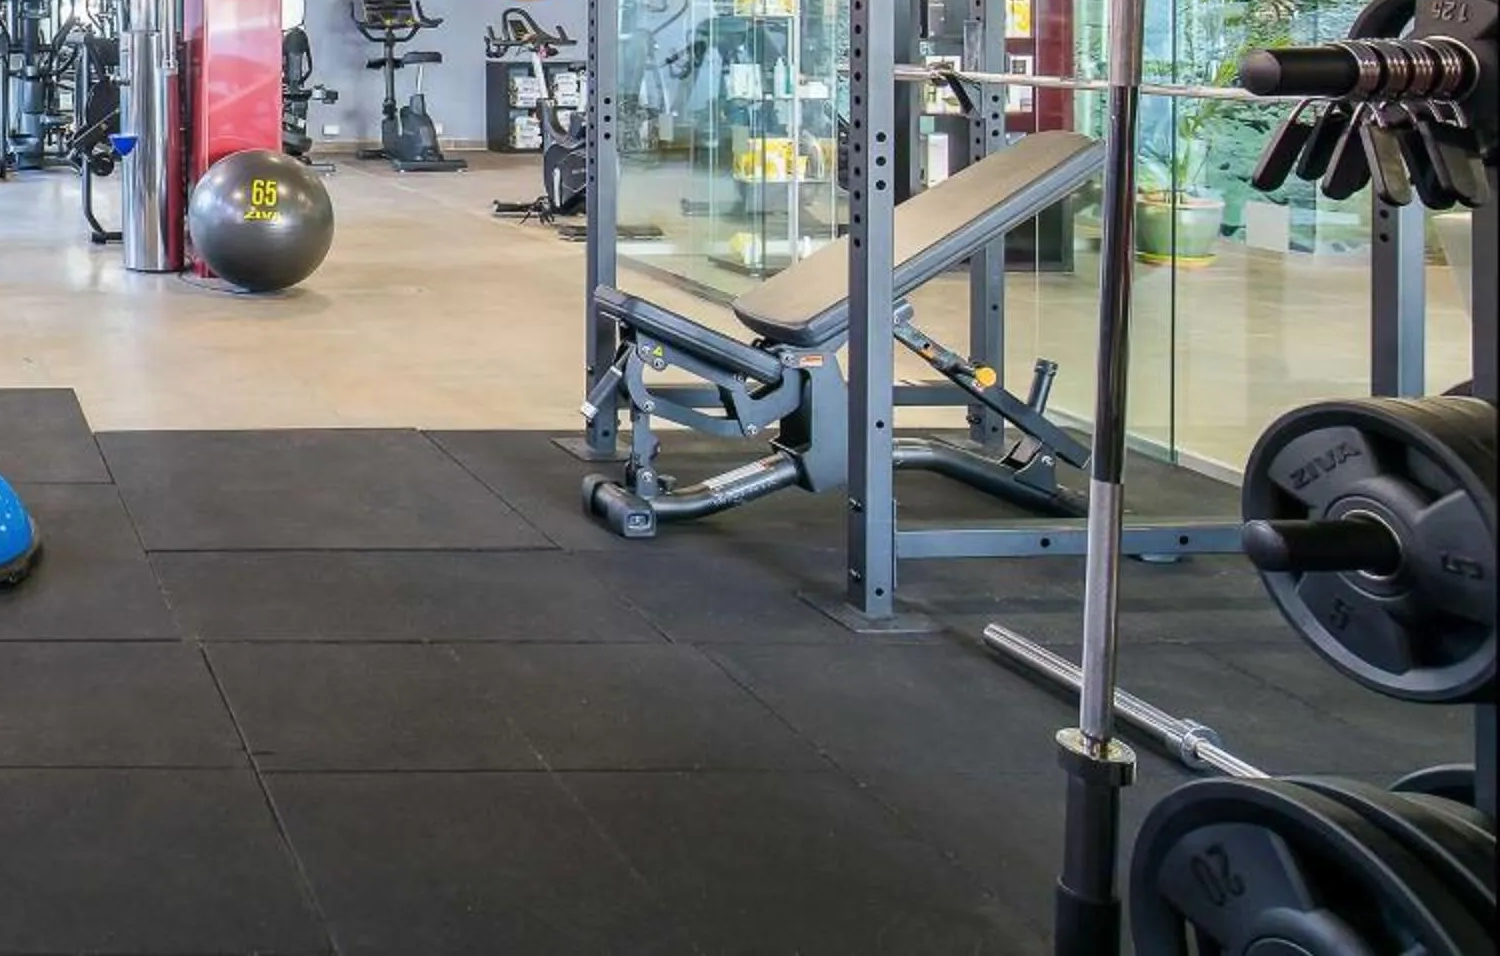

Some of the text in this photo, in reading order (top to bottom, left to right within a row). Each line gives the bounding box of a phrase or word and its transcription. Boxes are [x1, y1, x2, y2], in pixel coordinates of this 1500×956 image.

[252, 179, 277, 207] 65
[1289, 441, 1364, 490] ZIVA
[1190, 843, 1247, 908] 20
